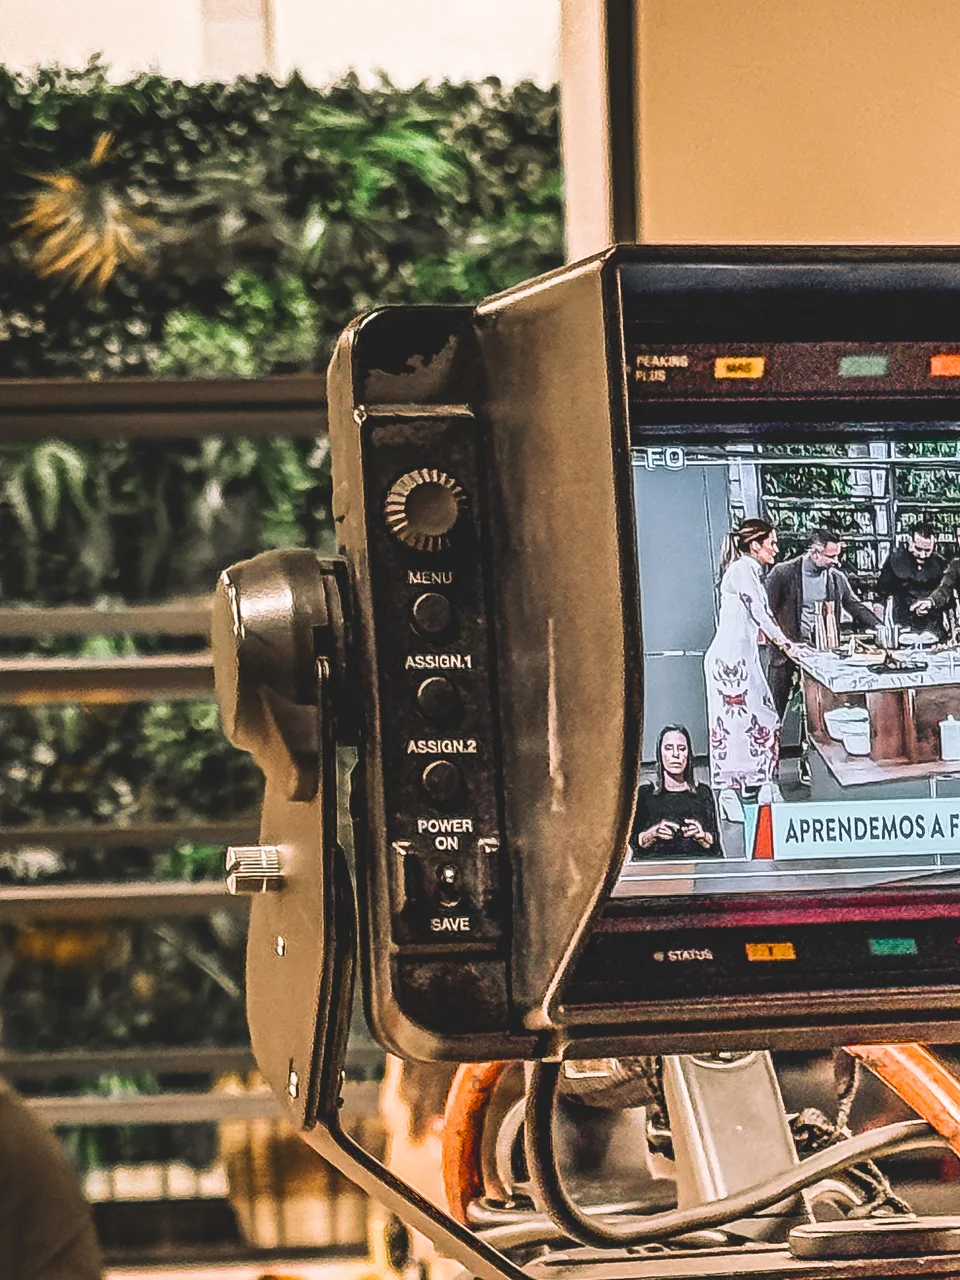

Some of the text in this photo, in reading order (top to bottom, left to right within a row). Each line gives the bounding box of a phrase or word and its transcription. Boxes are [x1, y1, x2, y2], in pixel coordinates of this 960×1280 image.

[408, 570, 453, 584] MENU
[417, 819, 473, 833] POWER
[785, 814, 926, 843] APRENDEMOS
[931, 813, 945, 838] A
[435, 836, 458, 850] ON
[431, 917, 470, 931] SAVE
[667, 949, 713, 961] STATUS
